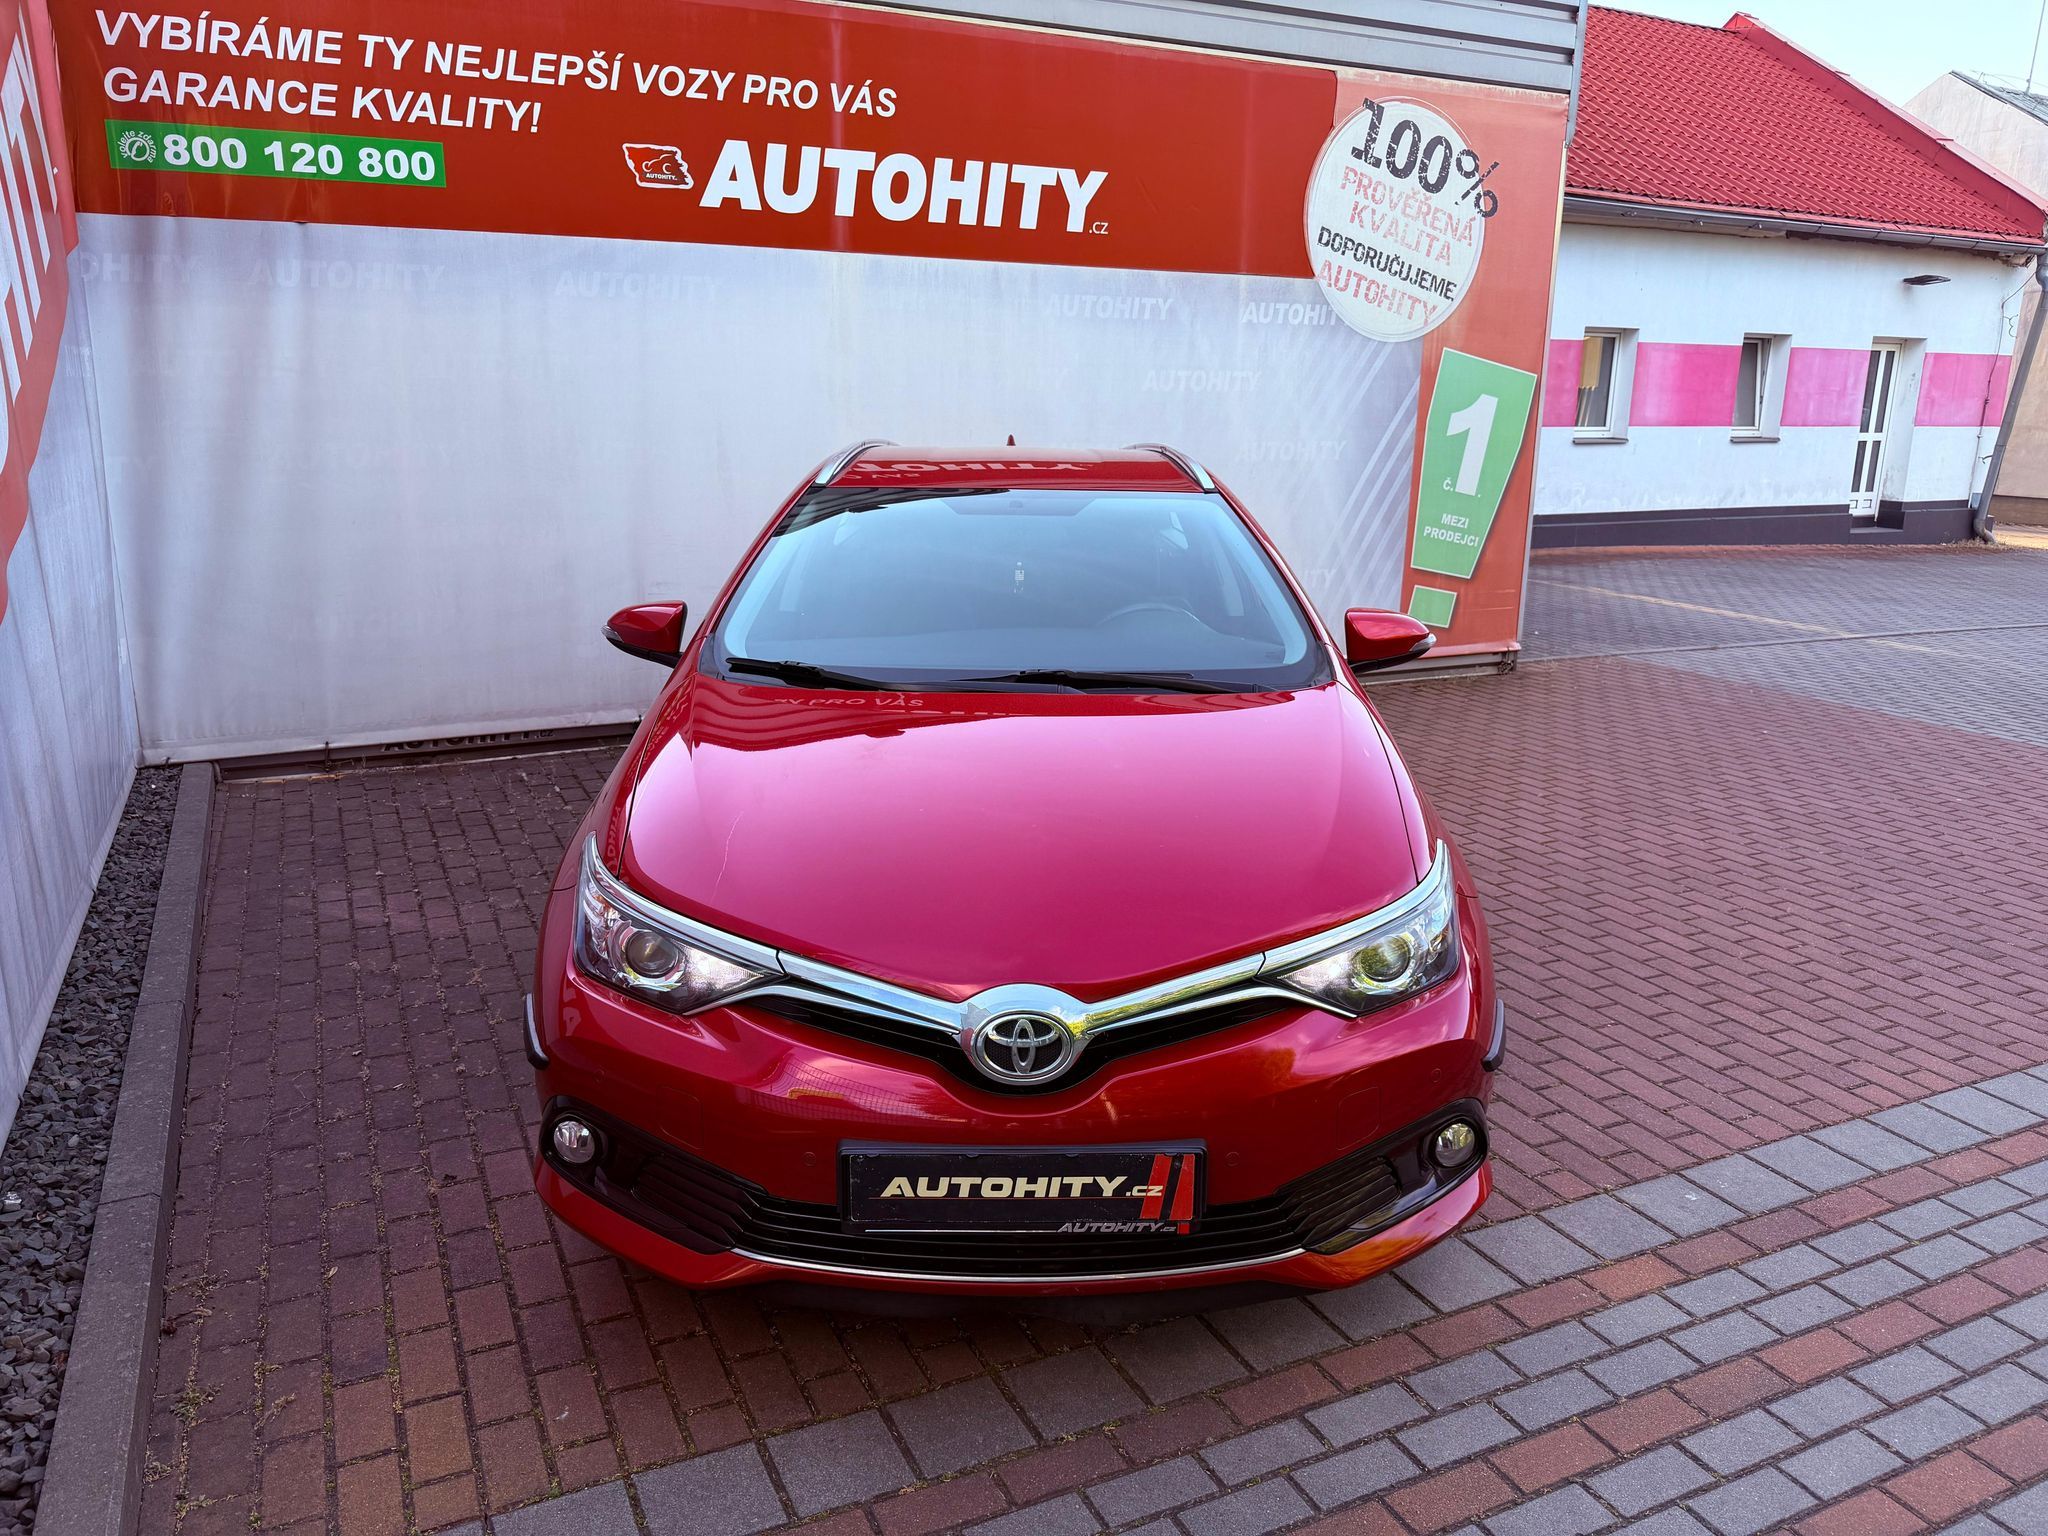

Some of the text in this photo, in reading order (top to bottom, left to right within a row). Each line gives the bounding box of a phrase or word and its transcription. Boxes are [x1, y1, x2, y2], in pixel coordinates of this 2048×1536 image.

[95, 10, 897, 118] VYBÍRÁME TY NEJLEPŠÍ VOZY PRO VÁS
[103, 67, 542, 133] GARANCE KVALITY!
[163, 134, 436, 182] 800 120 800
[1351, 98, 1500, 218] 100%
[1340, 165, 1477, 247] PROVĚŘENÁ
[1349, 201, 1452, 266] KVALITA
[249, 255, 447, 292] AUTOHITY
[1317, 226, 1458, 302] DOPORUČUJEME
[1046, 293, 1176, 321] AUTOHITY
[1241, 302, 1349, 327] AUTOHIT
[1315, 260, 1440, 327] AUTOHITY
[1141, 369, 1262, 393] AUTOHITY
[1423, 526, 1479, 547] PRODEJCI
[1441, 513, 1469, 529] MEZI
